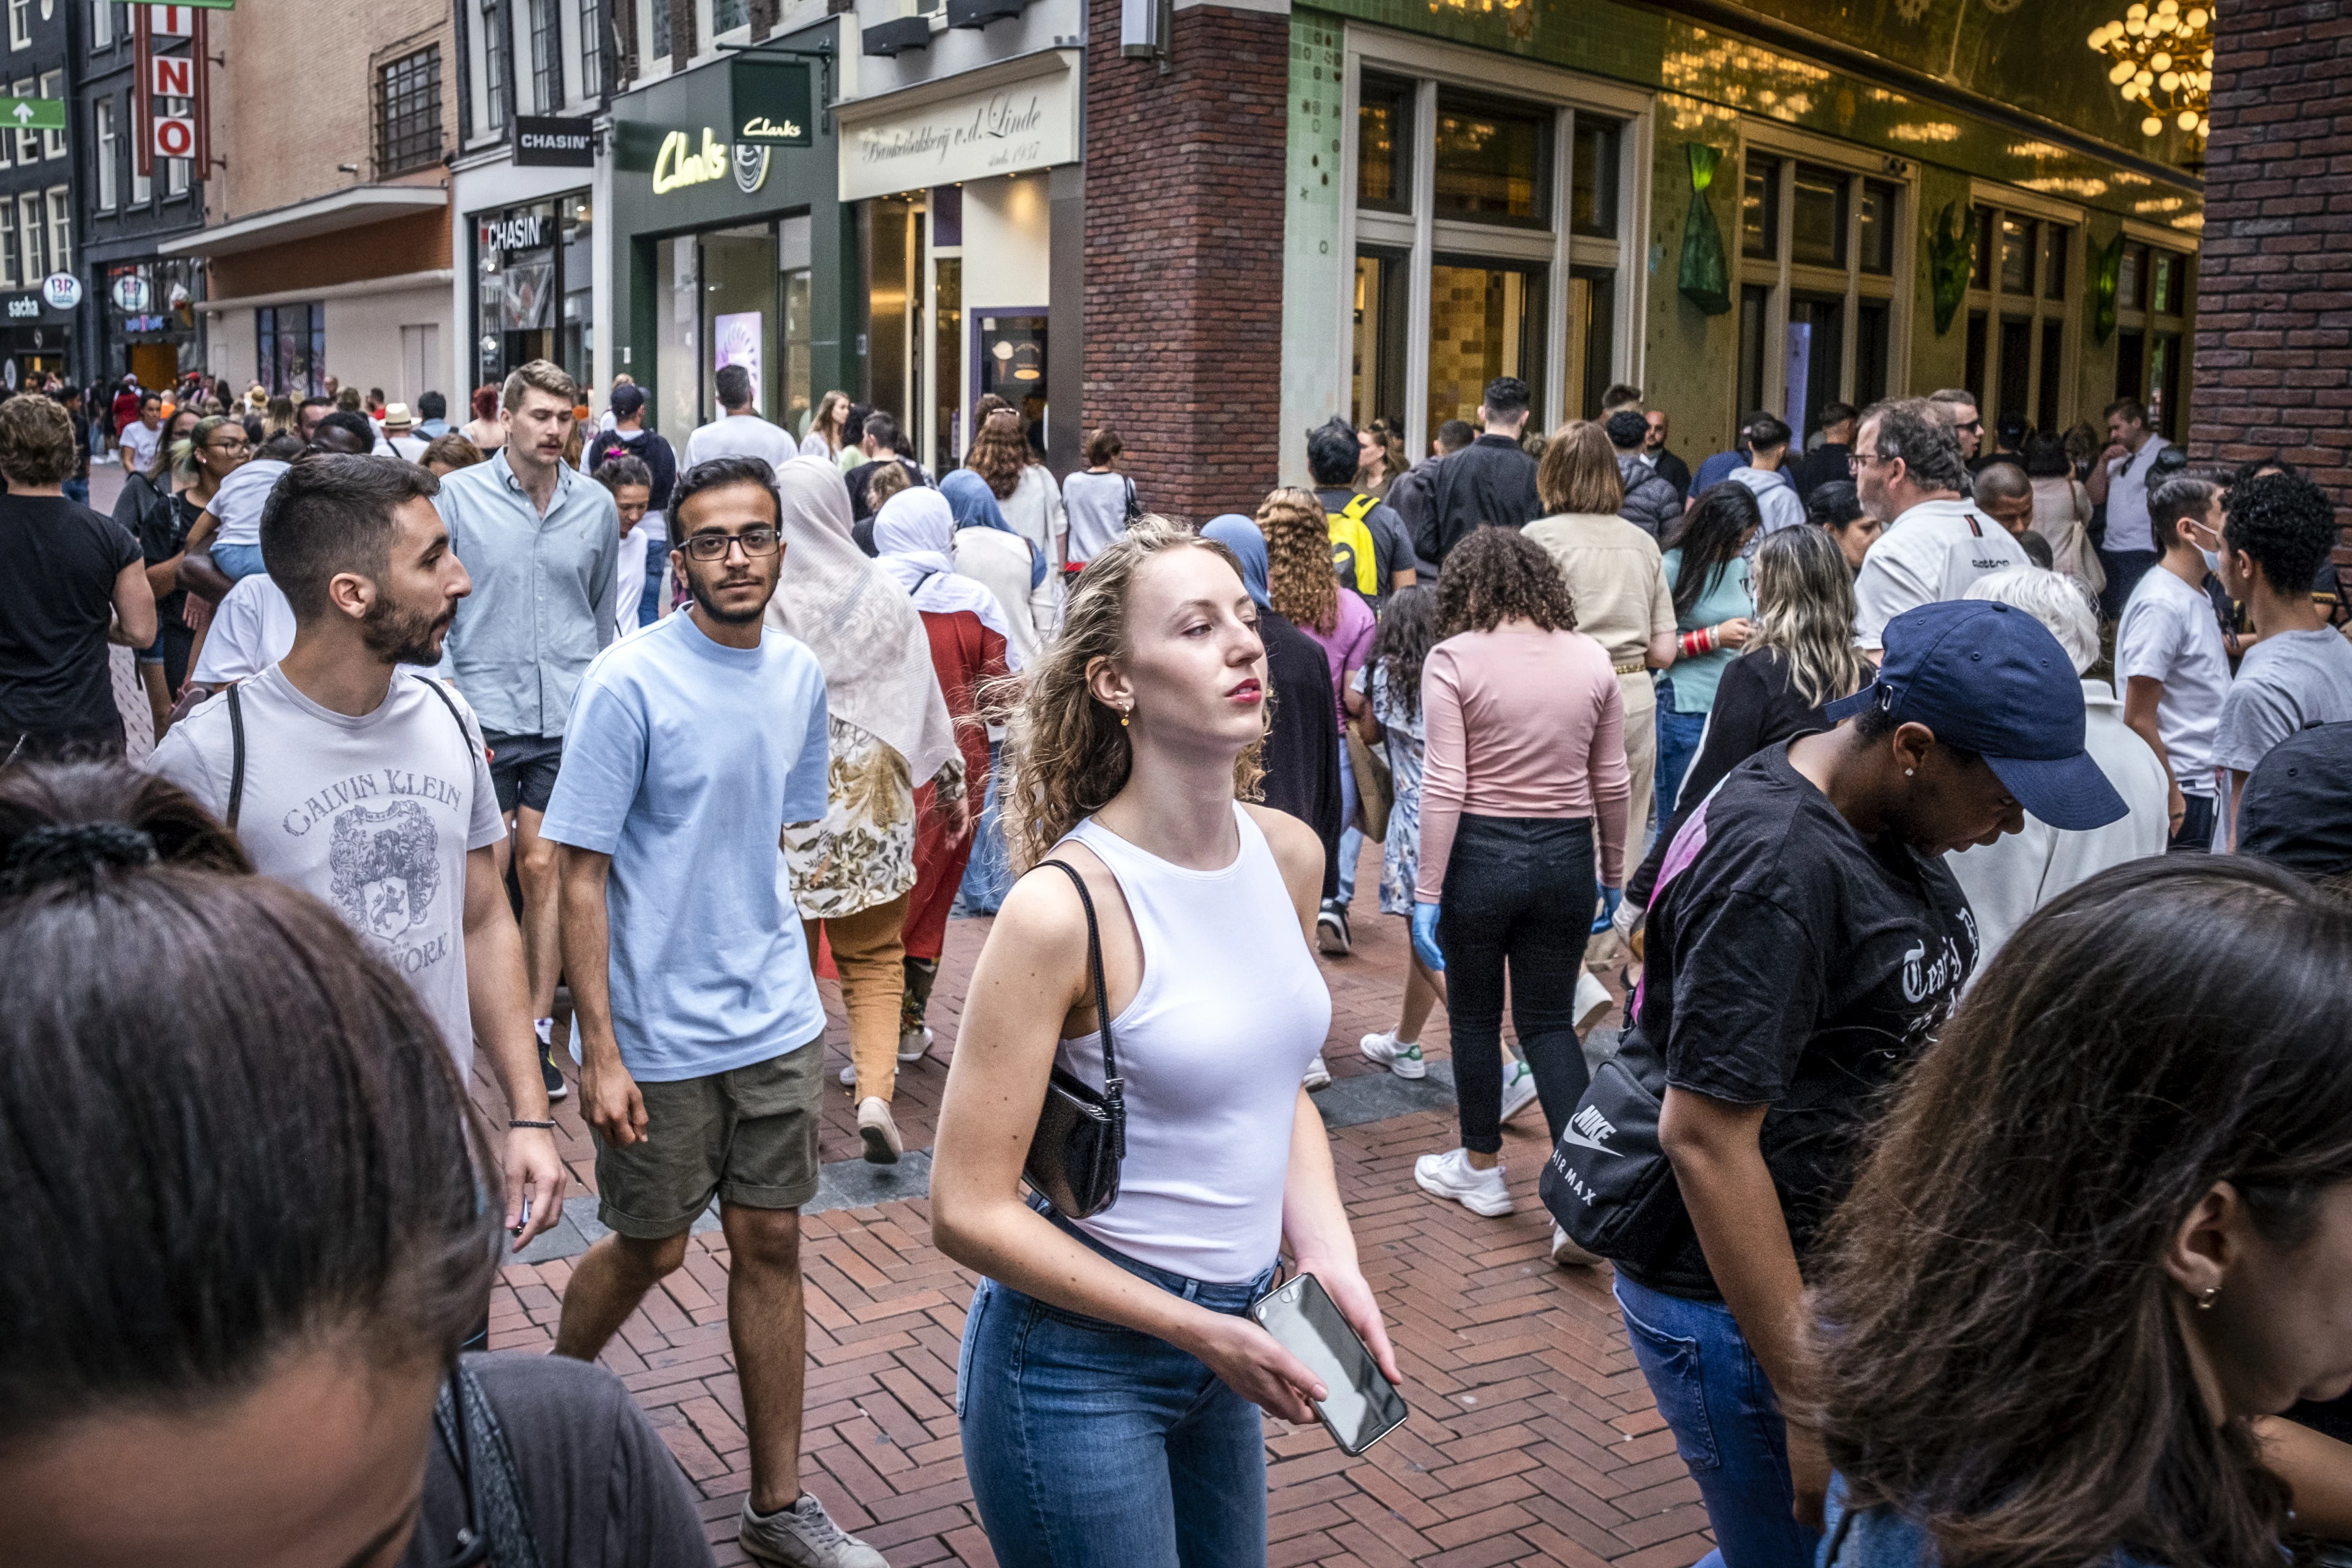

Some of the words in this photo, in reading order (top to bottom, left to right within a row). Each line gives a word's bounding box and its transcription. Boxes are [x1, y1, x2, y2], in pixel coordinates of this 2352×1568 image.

[743, 116, 801, 137] Clarks
[987, 92, 1041, 138] Linde
[521, 134, 590, 149] CHASIN'
[7, 295, 39, 317] sacha
[282, 773, 379, 836] CALVIN
[383, 769, 462, 812] KLEIN
[1573, 1104, 1617, 1147] NIKE
[1551, 1149, 1566, 1174] AIR
[1564, 1168, 1597, 1207] MAX
